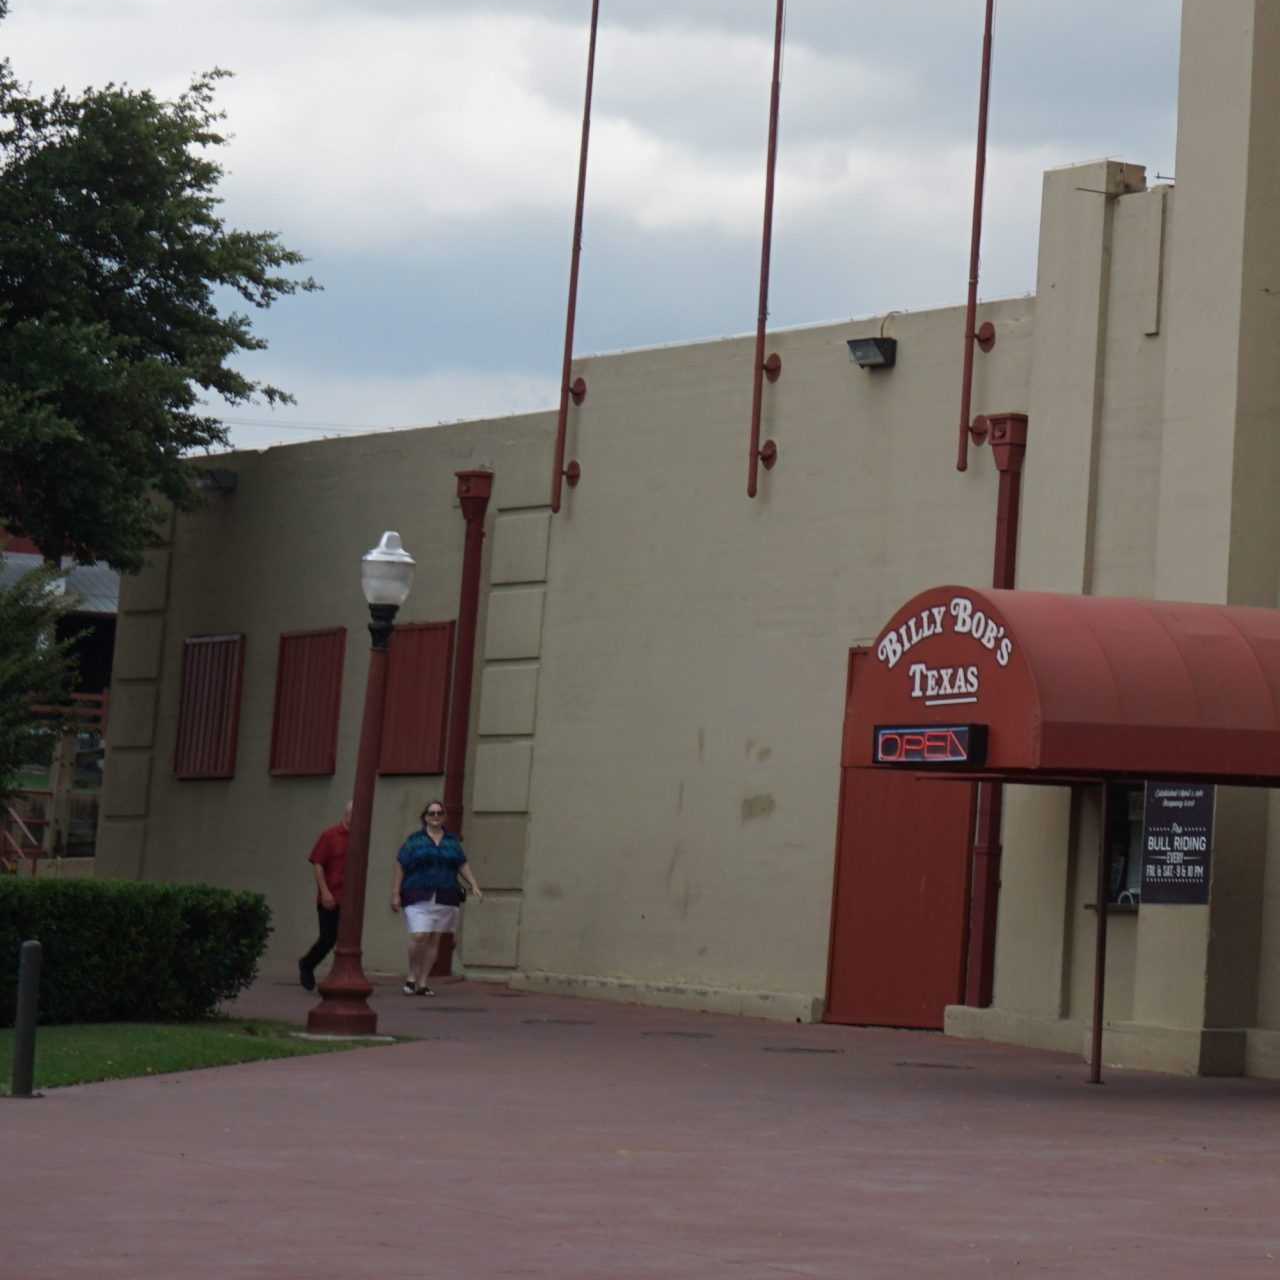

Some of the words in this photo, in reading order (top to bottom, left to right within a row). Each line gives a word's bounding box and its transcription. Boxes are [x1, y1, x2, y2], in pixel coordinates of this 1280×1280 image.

[877, 606, 946, 669] BILLY
[950, 597, 1012, 667] BOB'S
[909, 663, 979, 698] TEXAS
[879, 730, 968, 760] OPEN
[1148, 836, 1171, 850] BULL
[1174, 836, 1206, 850] RIDING
[1166, 852, 1184, 864] EVERY
[1195, 865, 1204, 877] PM
